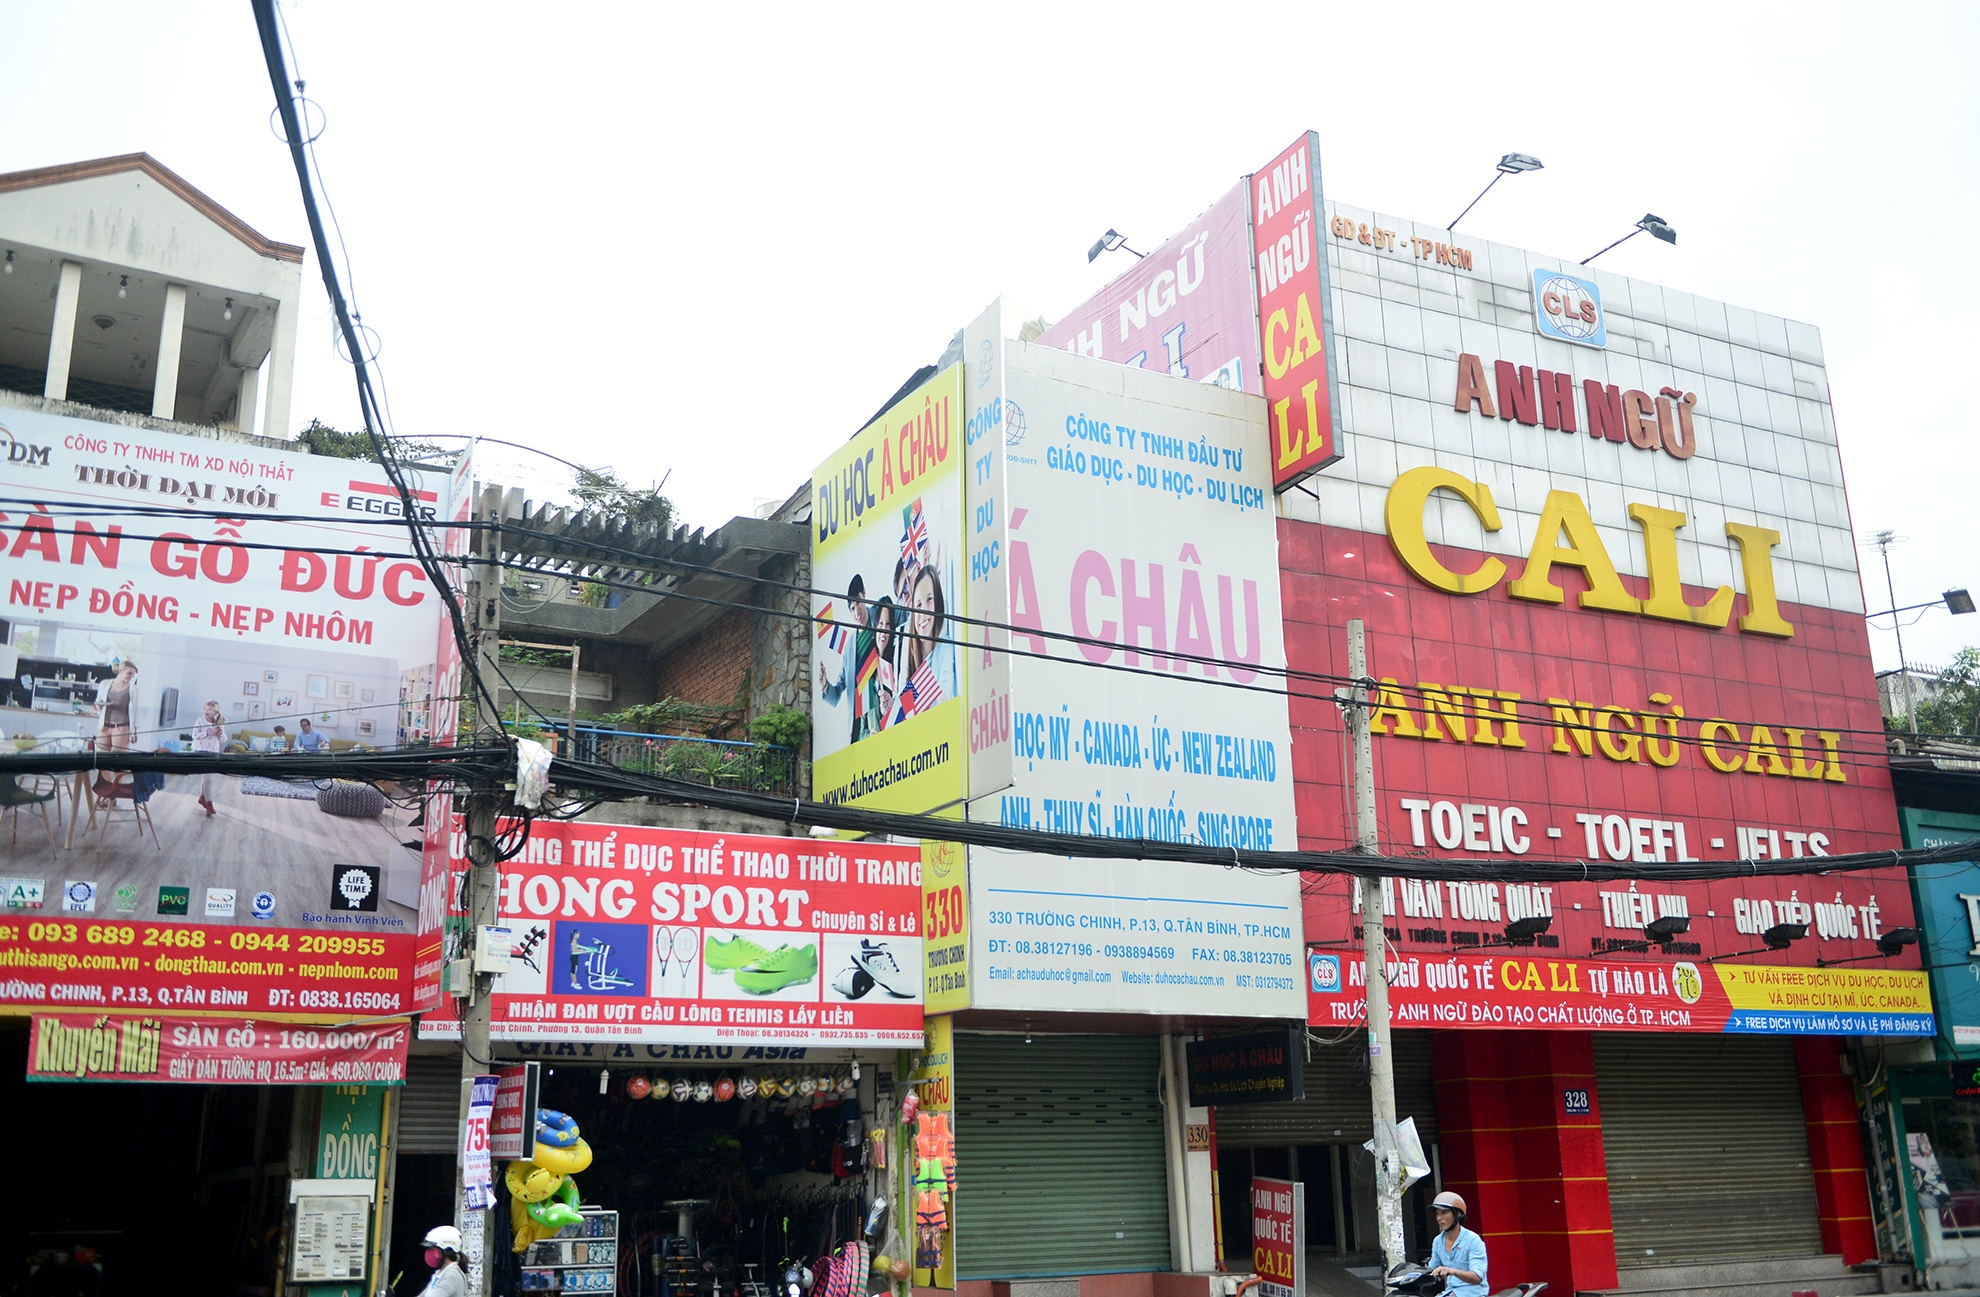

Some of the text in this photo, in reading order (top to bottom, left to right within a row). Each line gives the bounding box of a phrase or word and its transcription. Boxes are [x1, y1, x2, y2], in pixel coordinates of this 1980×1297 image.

[1257, 146, 1308, 227] ANH
[1258, 209, 1310, 299] NGỮ
[1119, 230, 1209, 342] NGỮ
[1543, 292, 1597, 324] CLS
[1265, 292, 1322, 380] CA
[967, 396, 1001, 446] CÔNG
[1274, 378, 1323, 470] LI
[1454, 352, 1697, 460] ANH NGỮ
[64, 434, 294, 481] CÔNG TY TNHH XD NỘI THẤT
[1066, 413, 1243, 472] CÔNG TY TNHH ĐẦU TƯ
[74, 464, 215, 505] THỜI ĐẠI
[819, 395, 949, 543] DU HỌC Á CHÂU
[976, 450, 993, 485] TY
[1047, 444, 1264, 512] GIÁO DỤC DU HỌC DU LỊCH
[977, 498, 993, 533] DU
[150, 518, 249, 584] GỖ
[280, 546, 426, 606] ĐỨC
[972, 540, 999, 582] HỌC
[1384, 466, 1794, 638] CALI
[9, 579, 374, 645] NẸP ĐỒNG NẸP NHÔM
[1009, 507, 1261, 684] Á CHÂU
[983, 610, 992, 670] Á
[970, 688, 1009, 754] CHÂU
[1014, 703, 1276, 782] HỌC MỸ CANADA ÚC NEW ZEALAND
[1370, 677, 1848, 783] ANH NGỮ CALI
[822, 741, 949, 806] www.duhocachau.com.vn
[1001, 790, 1272, 851] ANH HÀN QUỐC SINGAPORE
[1401, 798, 1830, 863] TOEIC TOEFL IELTS
[348, 876, 365, 884] LIFE
[571, 831, 922, 886] THỂ DỤC THỂ THAO THỜI TRANG
[345, 885, 367, 894] TIME
[651, 881, 810, 927] SPORT
[812, 910, 865, 931] Chuyên
[926, 885, 962, 940] 330
[989, 910, 1291, 939] 330 TRƯỜNG CHINH, TP.HCM
[1733, 897, 1774, 934] GIAO
[1814, 891, 1858, 941] QUỐC
[1858, 895, 1882, 940] TẾ
[28, 922, 386, 956] 093 689 2468 0944 209955
[1015, 940, 1292, 966] 08.38127196 0938894569 08.38123705
[155, 954, 283, 975] dongthau.com.vn
[299, 964, 398, 980] nepnhom.com
[1017, 967, 1111, 984] achauduhoc@gmail.com
[1155, 971, 1224, 986] duhocachau.com.vn
[1425, 957, 1645, 998] QUỐC TỰ HÀO
[1674, 974, 1700, 999] 10
[1782, 973, 1829, 988] FREE DỊCH
[50, 984, 106, 1003] CHINH,
[158, 985, 205, 1005] Q.TÂN
[210, 986, 248, 1005] BÌNH
[299, 990, 400, 1009] 0838.165064
[509, 1000, 854, 1025] NHẬN ĐAN CẦU LÔNG TENNIS LẤY LIỀN
[1398, 1001, 1691, 1027] ANH NGỮ ĐÀO TẠO CHẤT LƯỢNG HCM
[173, 1020, 256, 1048] SÀN GỖ
[538, 1025, 568, 1034] Phường
[717, 1029, 734, 1037] Điện
[1746, 1016, 1791, 1031] FREE DỊCH
[36, 1015, 162, 1077] Khuyến Mãi
[170, 1052, 194, 1079] GIẤY
[196, 1051, 218, 1078] DÁN
[221, 1055, 255, 1080] TƯỜNG
[1194, 1044, 1284, 1074] DU HỌC CHÂU
[1565, 1092, 1587, 1107] 328
[323, 1113, 377, 1179] ĐỒNG
[1188, 1127, 1208, 1142] 330
[1255, 1214, 1277, 1240] QUỐC
